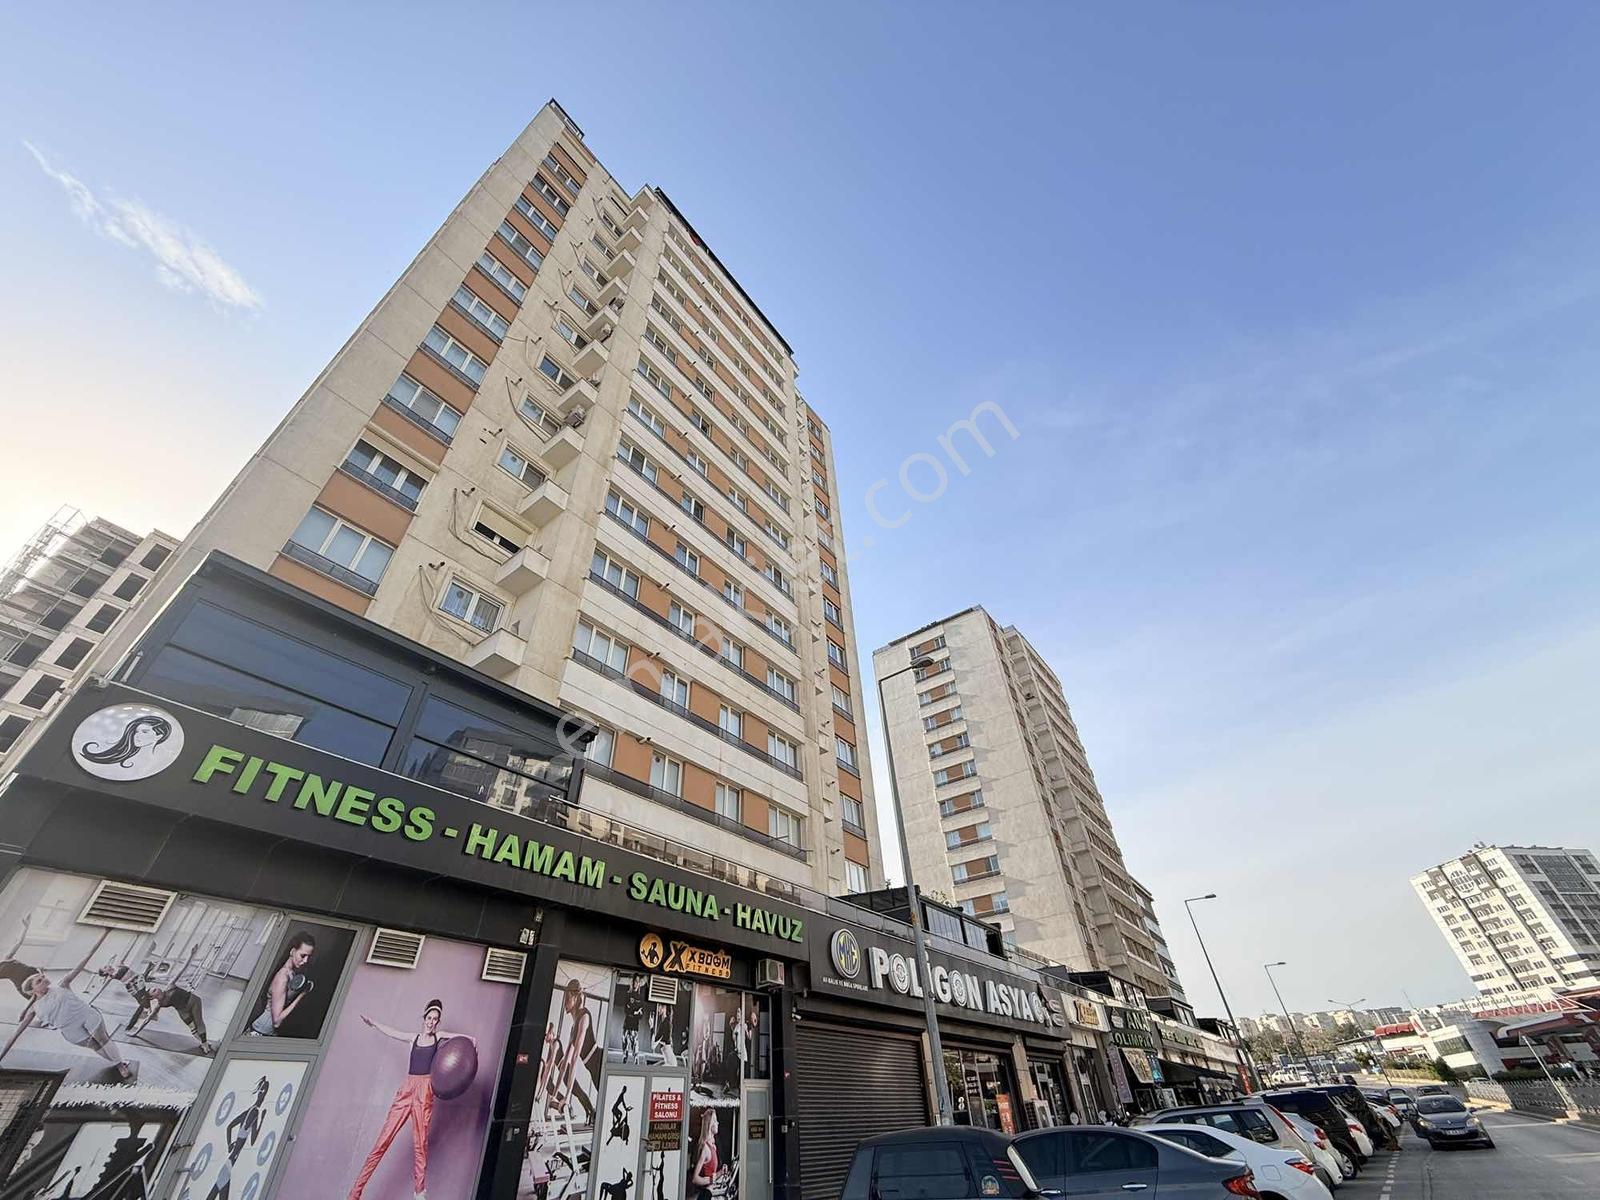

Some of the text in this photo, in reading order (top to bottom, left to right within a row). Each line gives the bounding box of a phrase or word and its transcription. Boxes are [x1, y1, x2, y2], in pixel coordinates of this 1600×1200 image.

[192, 744, 436, 842] FITNESS
[465, 823, 606, 889] HAMAM
[630, 871, 720, 921] SAUNA
[735, 902, 804, 943] HAVUZ
[685, 963, 730, 978] FITNESS
[985, 980, 1034, 1022] ASYA
[676, 1093, 682, 1101] &
[654, 1101, 679, 1110] FİTNESS
[654, 1111, 678, 1119] SALONU
